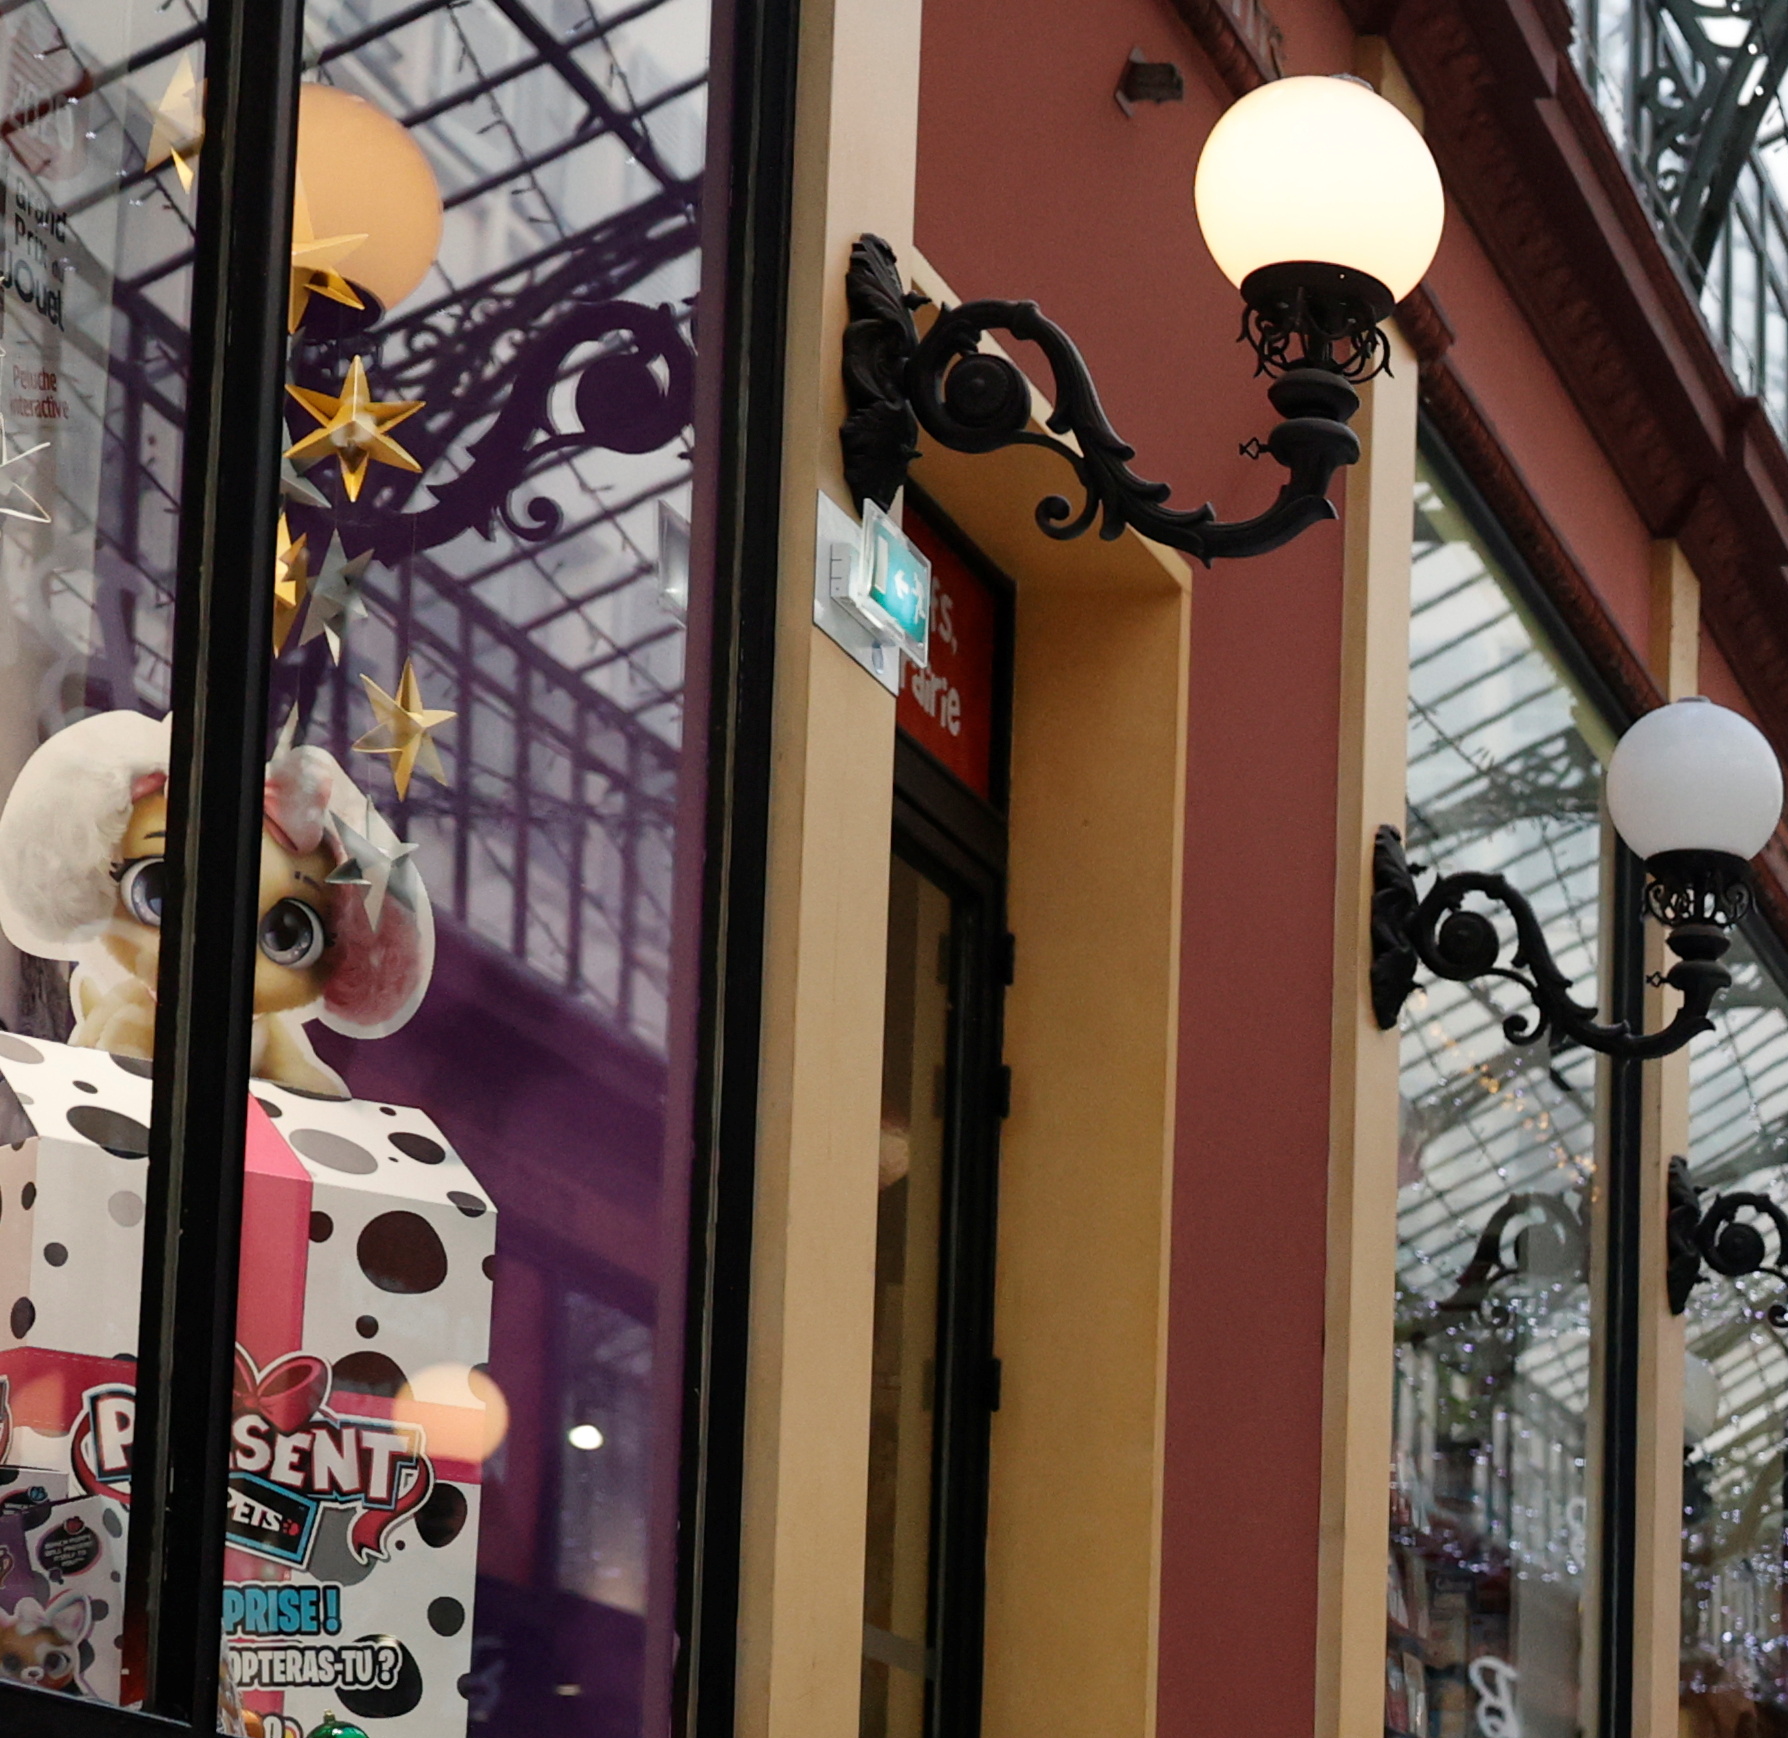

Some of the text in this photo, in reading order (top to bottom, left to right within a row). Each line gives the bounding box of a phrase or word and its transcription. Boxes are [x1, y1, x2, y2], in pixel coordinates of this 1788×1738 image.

[228, 1487, 283, 1532] ETS
[224, 1588, 318, 1633] PRISE
[229, 1649, 374, 1686] OPTERAS-TU
